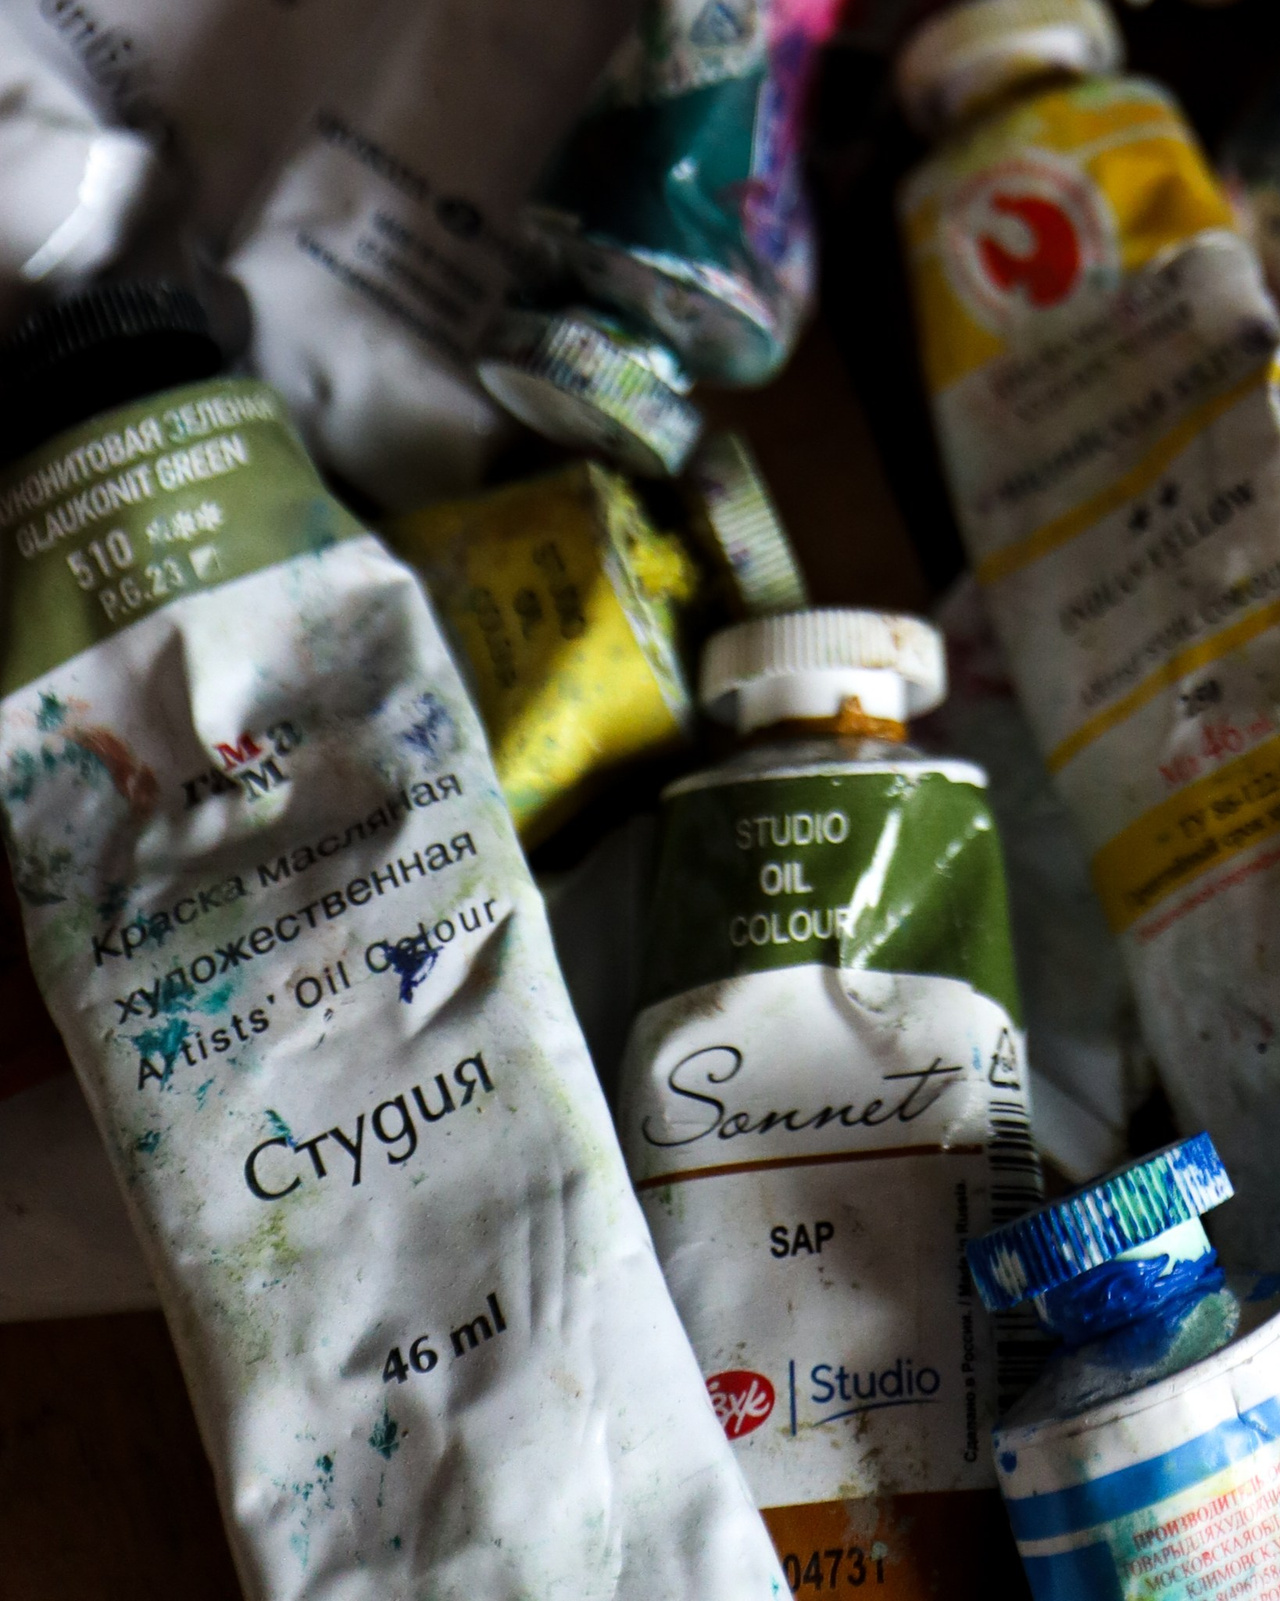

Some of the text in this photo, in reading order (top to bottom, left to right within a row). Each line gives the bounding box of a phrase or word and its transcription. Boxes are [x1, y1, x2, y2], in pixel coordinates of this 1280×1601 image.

[16, 433, 249, 559] GLAUKONIT GREEN
[66, 528, 134, 590] 510
[736, 811, 849, 850] STUDIO
[92, 772, 463, 967] Краска масляная
[760, 862, 813, 896] OIL
[114, 831, 478, 1024] художественная
[294, 960, 351, 1010] Oil
[642, 1045, 963, 1148] Sonnet
[770, 1221, 834, 1258] SAP
[382, 1292, 507, 1385] 46 ml
[811, 1359, 940, 1403] Studio
